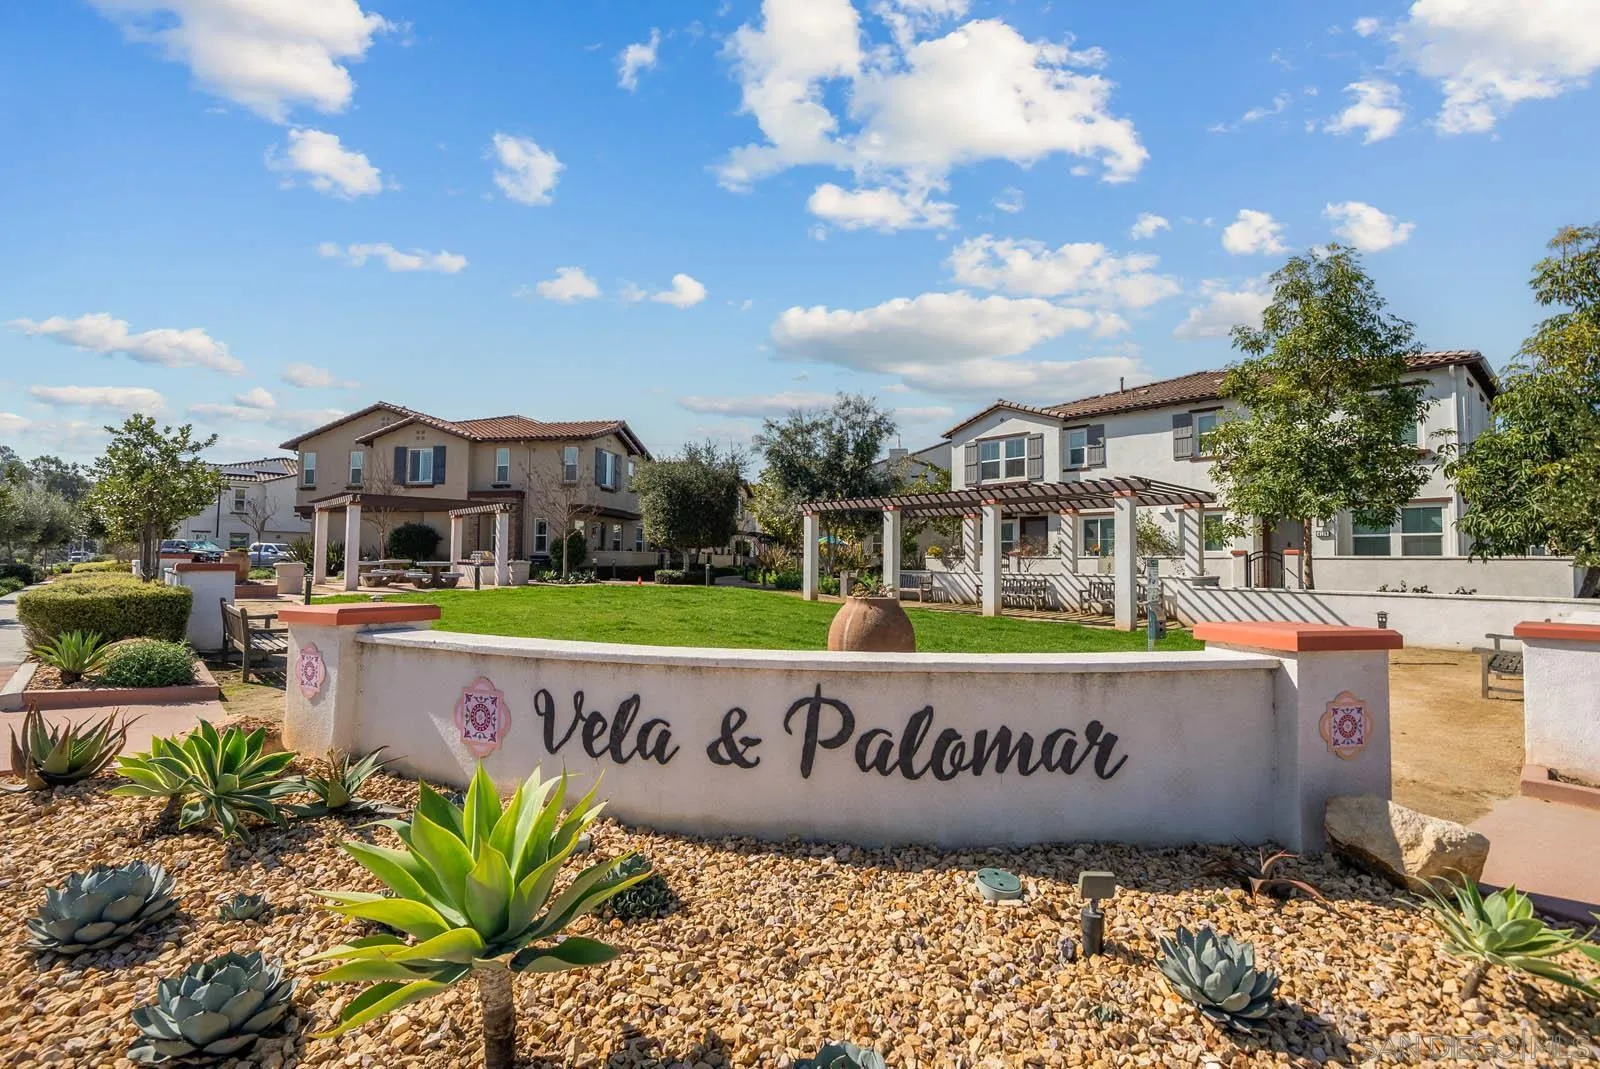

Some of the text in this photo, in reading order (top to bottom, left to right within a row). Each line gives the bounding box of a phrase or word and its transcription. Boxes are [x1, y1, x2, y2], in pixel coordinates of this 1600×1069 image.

[533, 683, 1129, 783] Vela & Palomar
